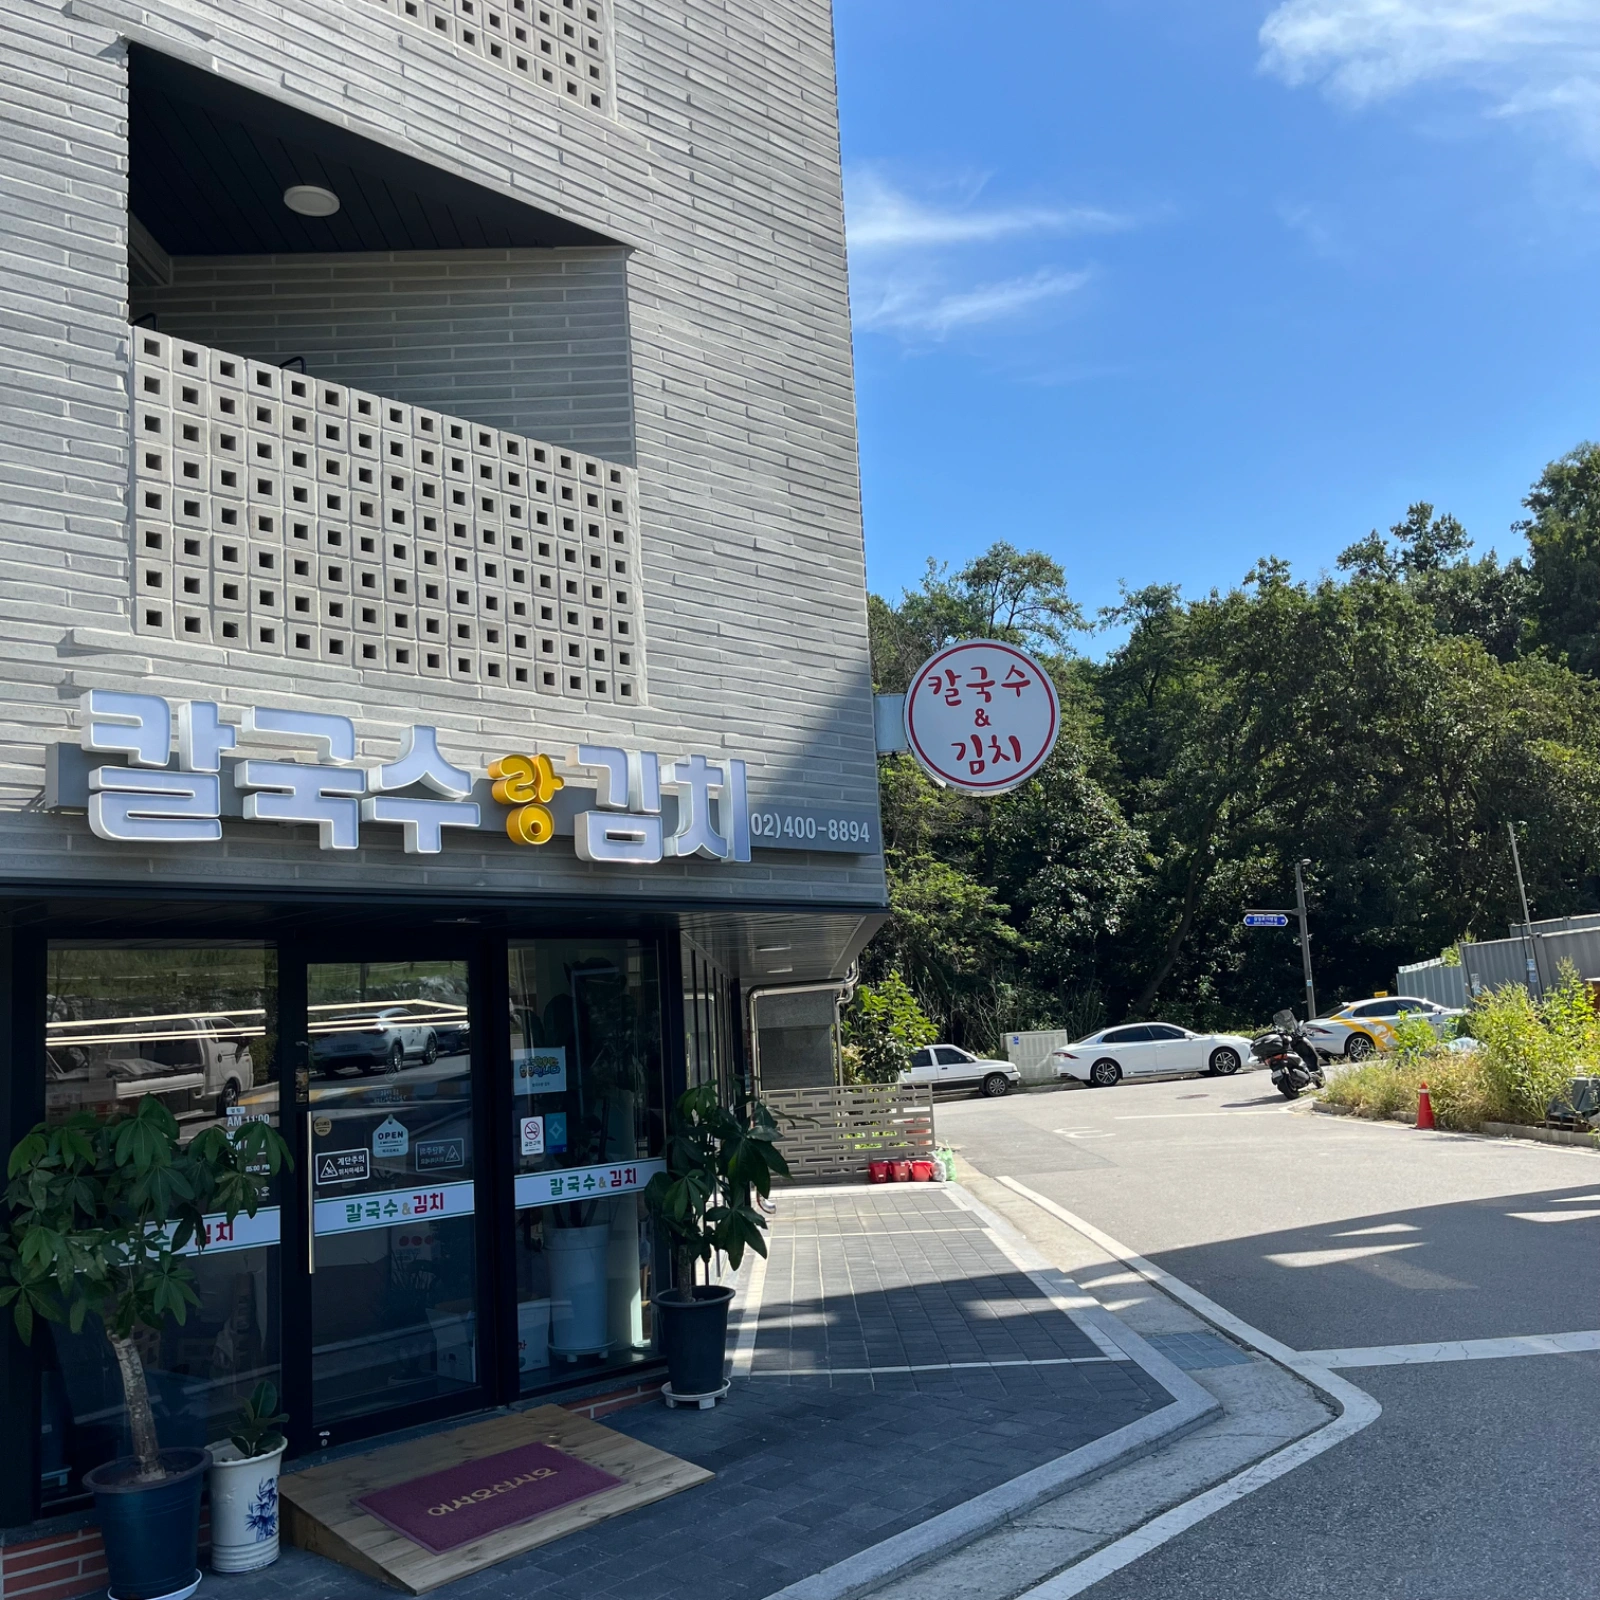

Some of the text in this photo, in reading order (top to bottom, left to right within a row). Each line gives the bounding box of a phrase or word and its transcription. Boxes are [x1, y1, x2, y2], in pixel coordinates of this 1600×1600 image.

[928, 664, 1031, 706] 칼국수
[974, 708, 992, 727] &
[951, 734, 1022, 775] 김치
[751, 811, 870, 843] 02)400-8894
[227, 1115, 242, 1127] AM
[377, 1131, 403, 1140] OPEN
[337, 1154, 365, 1165] 계단주의
[427, 1467, 559, 1516] 어서오십시오
